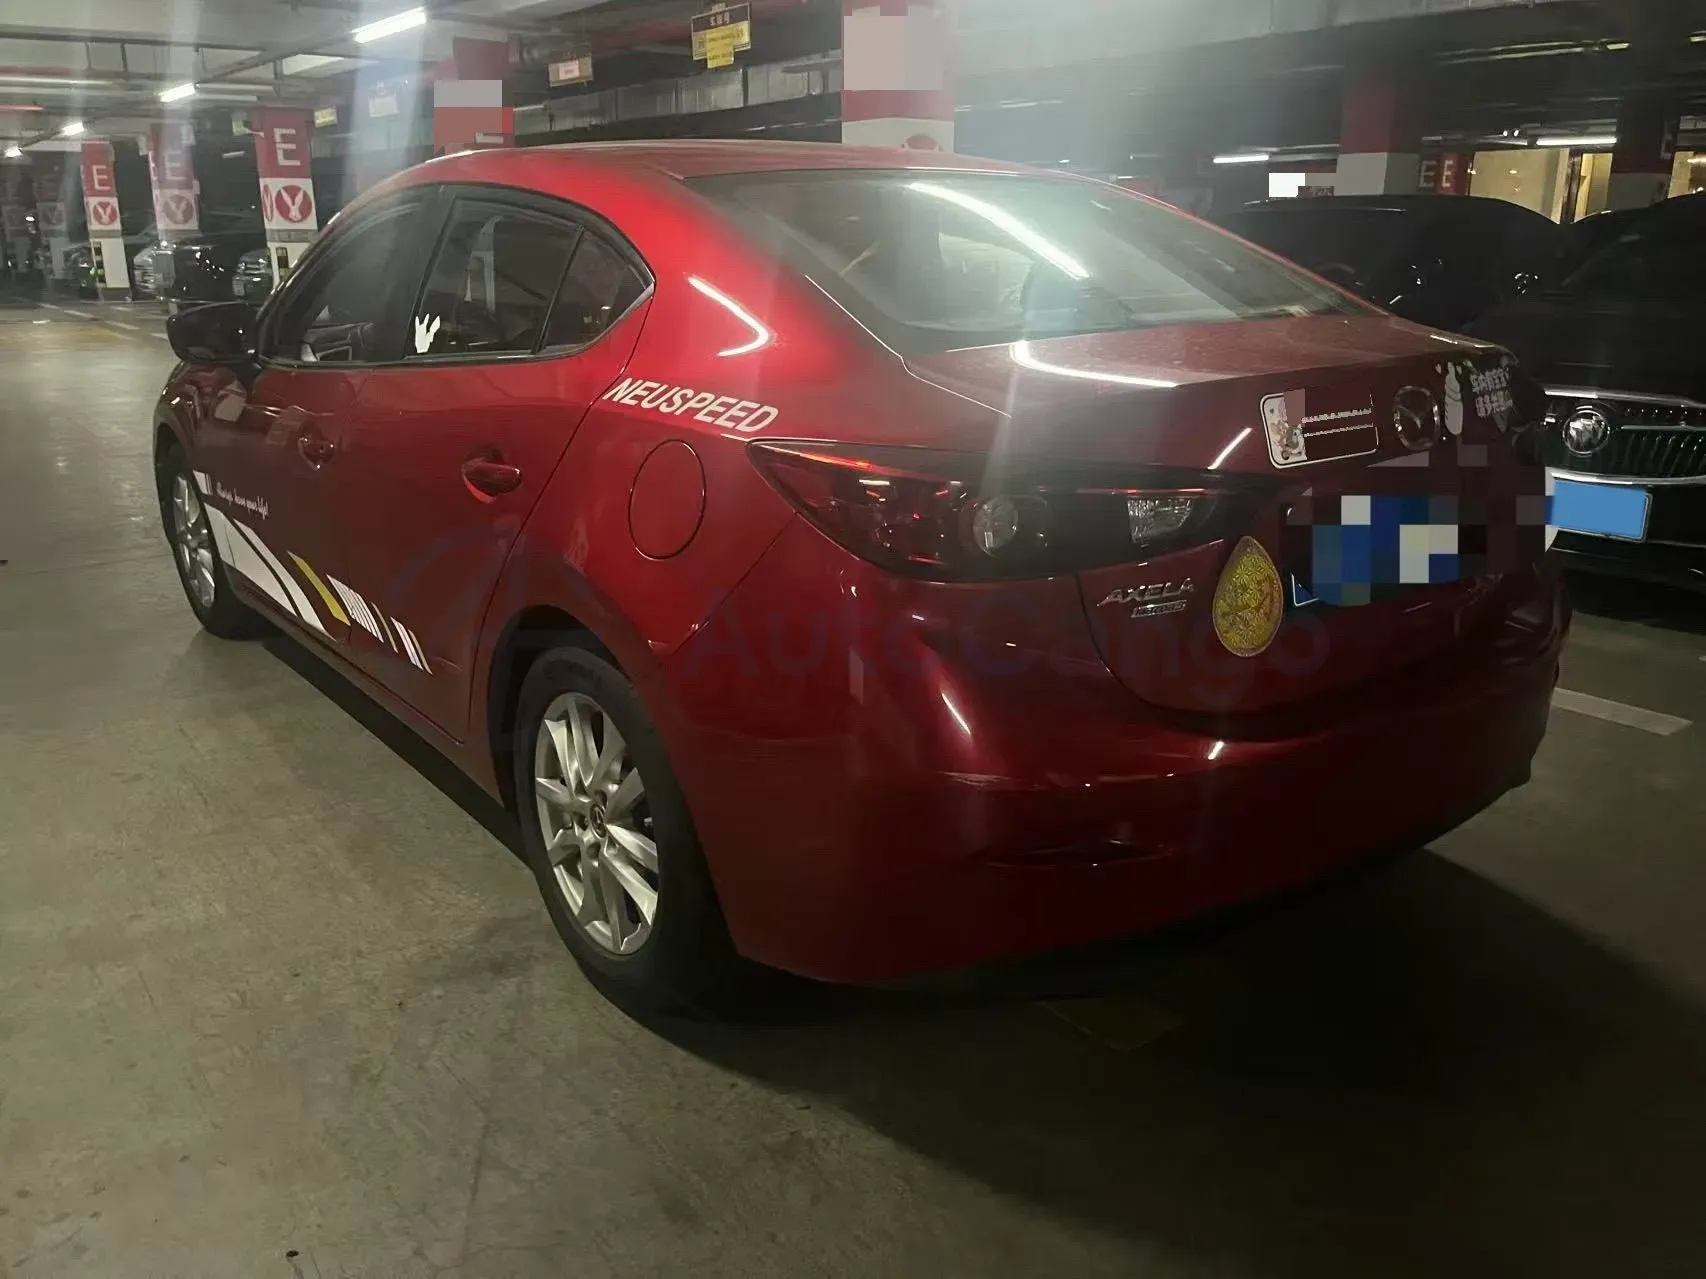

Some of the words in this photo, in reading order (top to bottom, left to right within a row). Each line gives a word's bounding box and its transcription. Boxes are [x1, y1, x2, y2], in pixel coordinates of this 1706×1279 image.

[274, 128, 301, 166] E
[92, 165, 111, 190] E
[164, 150, 187, 180] E
[1419, 160, 1437, 188] E
[1441, 160, 1454, 188] E
[602, 377, 779, 432] NEUSPEED
[1096, 577, 1194, 607] AXELA
